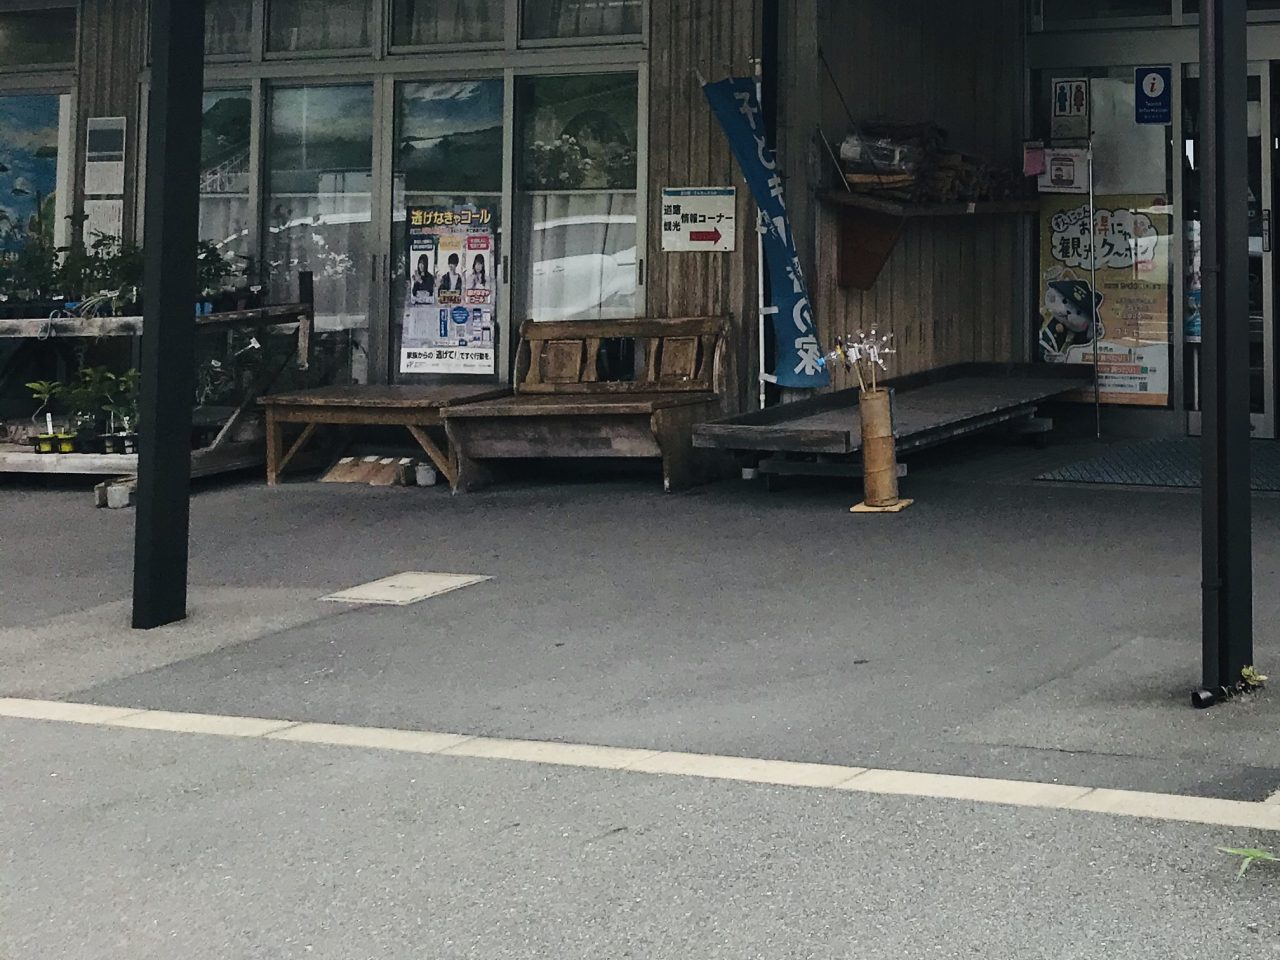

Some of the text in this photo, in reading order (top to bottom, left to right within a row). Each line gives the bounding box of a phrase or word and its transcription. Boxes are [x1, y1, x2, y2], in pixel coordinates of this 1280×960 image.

[664, 204, 681, 216] 道路
[411, 209, 491, 226] 逃げなきゃコール
[681, 213, 733, 224] 情報コーナー
[664, 221, 680, 231] 観光
